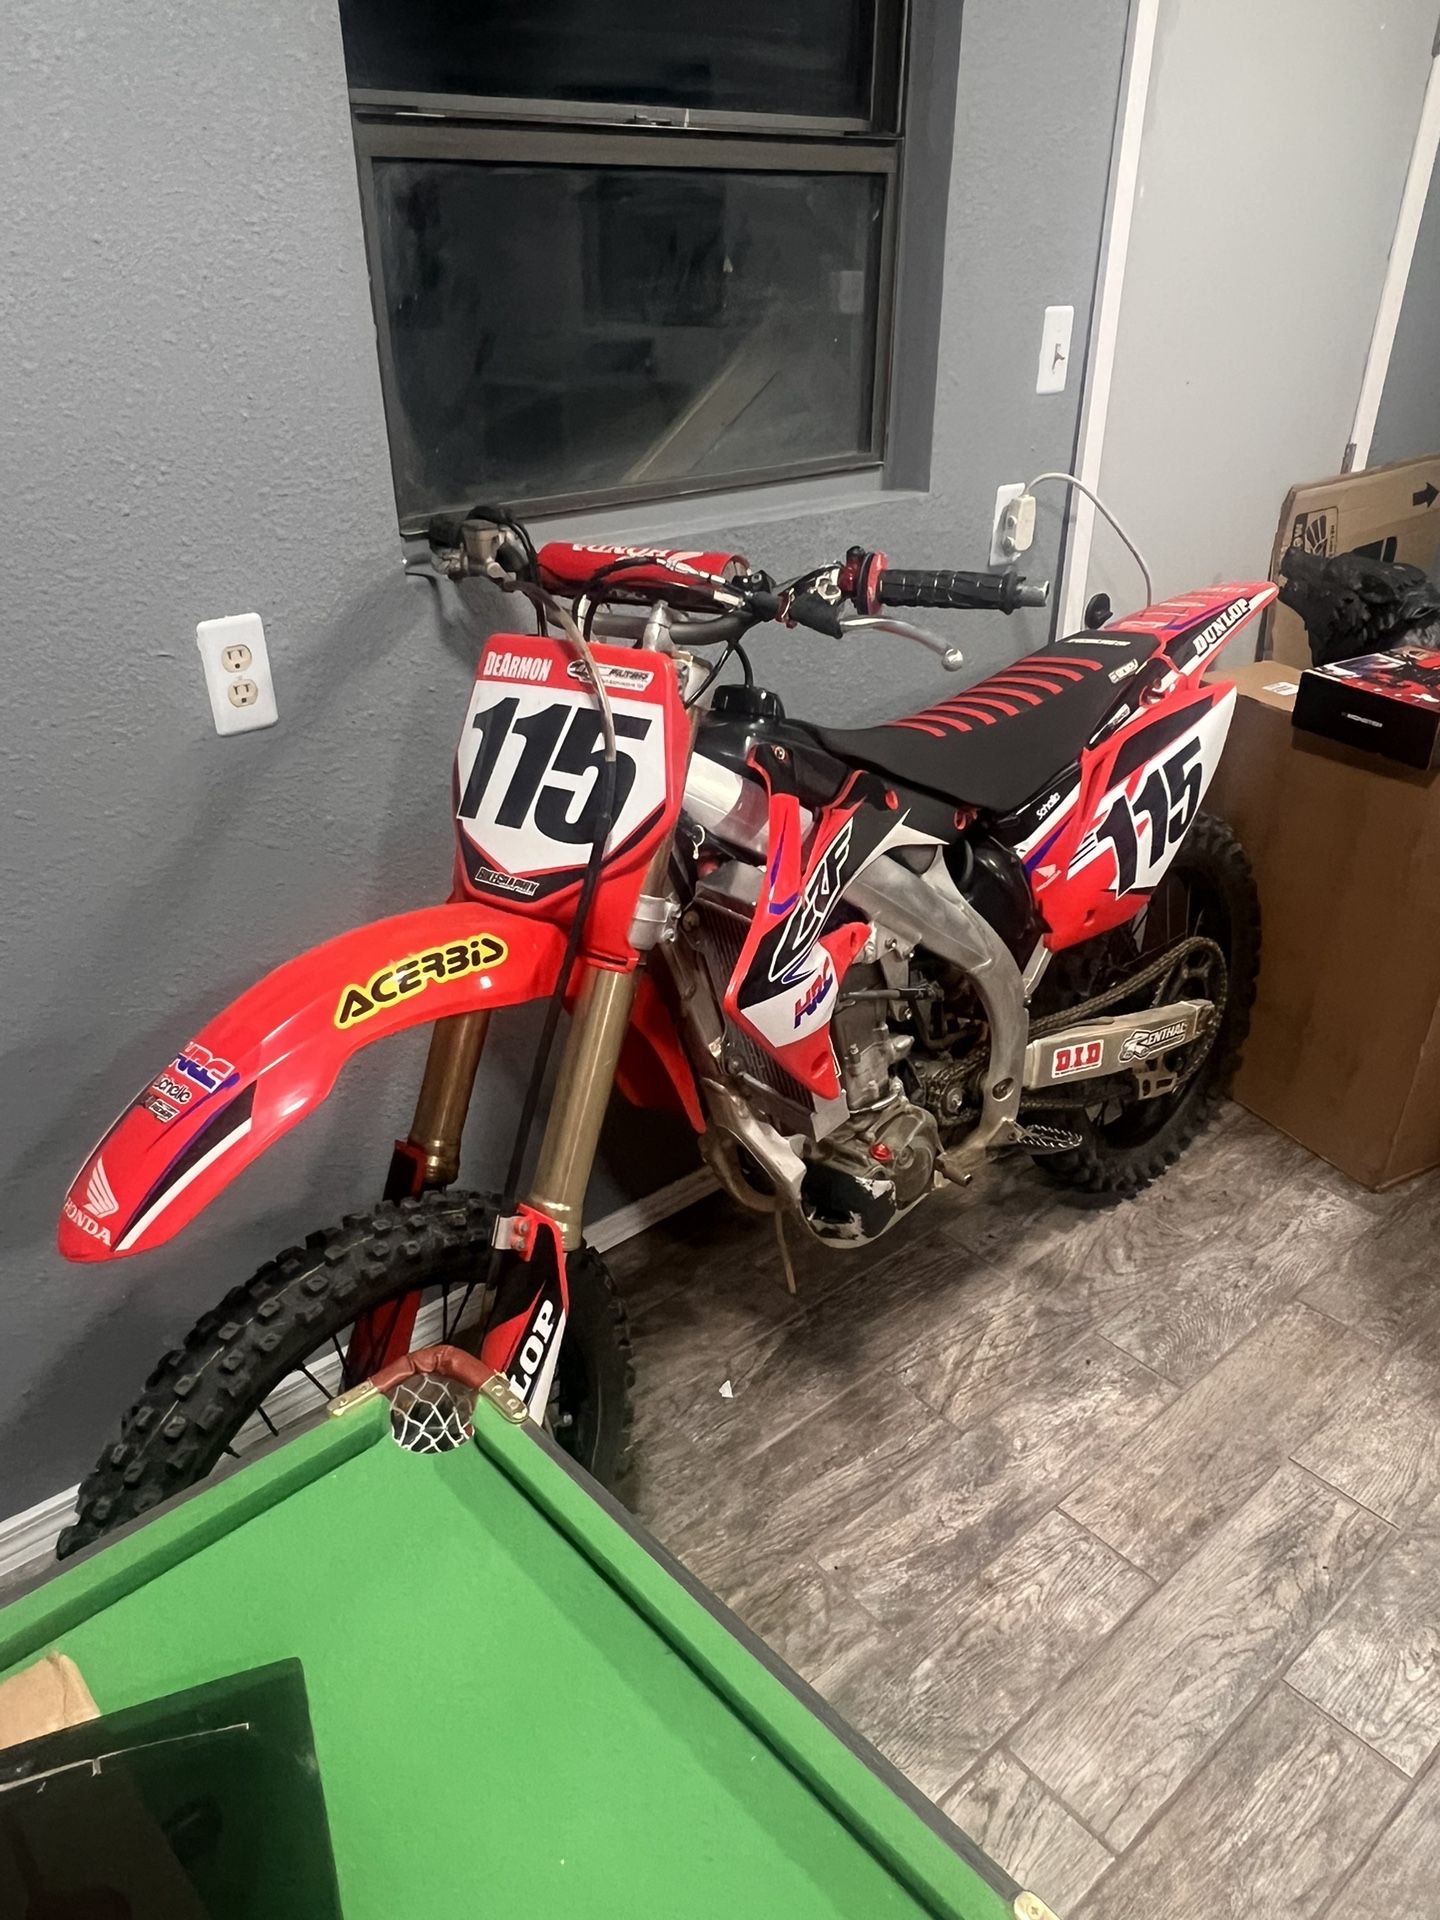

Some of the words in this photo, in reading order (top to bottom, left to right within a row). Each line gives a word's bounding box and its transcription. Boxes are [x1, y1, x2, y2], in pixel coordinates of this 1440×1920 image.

[1192, 597, 1250, 656] DUNLOP
[458, 697, 653, 845] 115
[1096, 735, 1203, 898] 115
[768, 816, 854, 983] CRF
[793, 955, 834, 1030] HRC
[64, 1197, 112, 1247] HONDA
[508, 1299, 555, 1402] LOP
